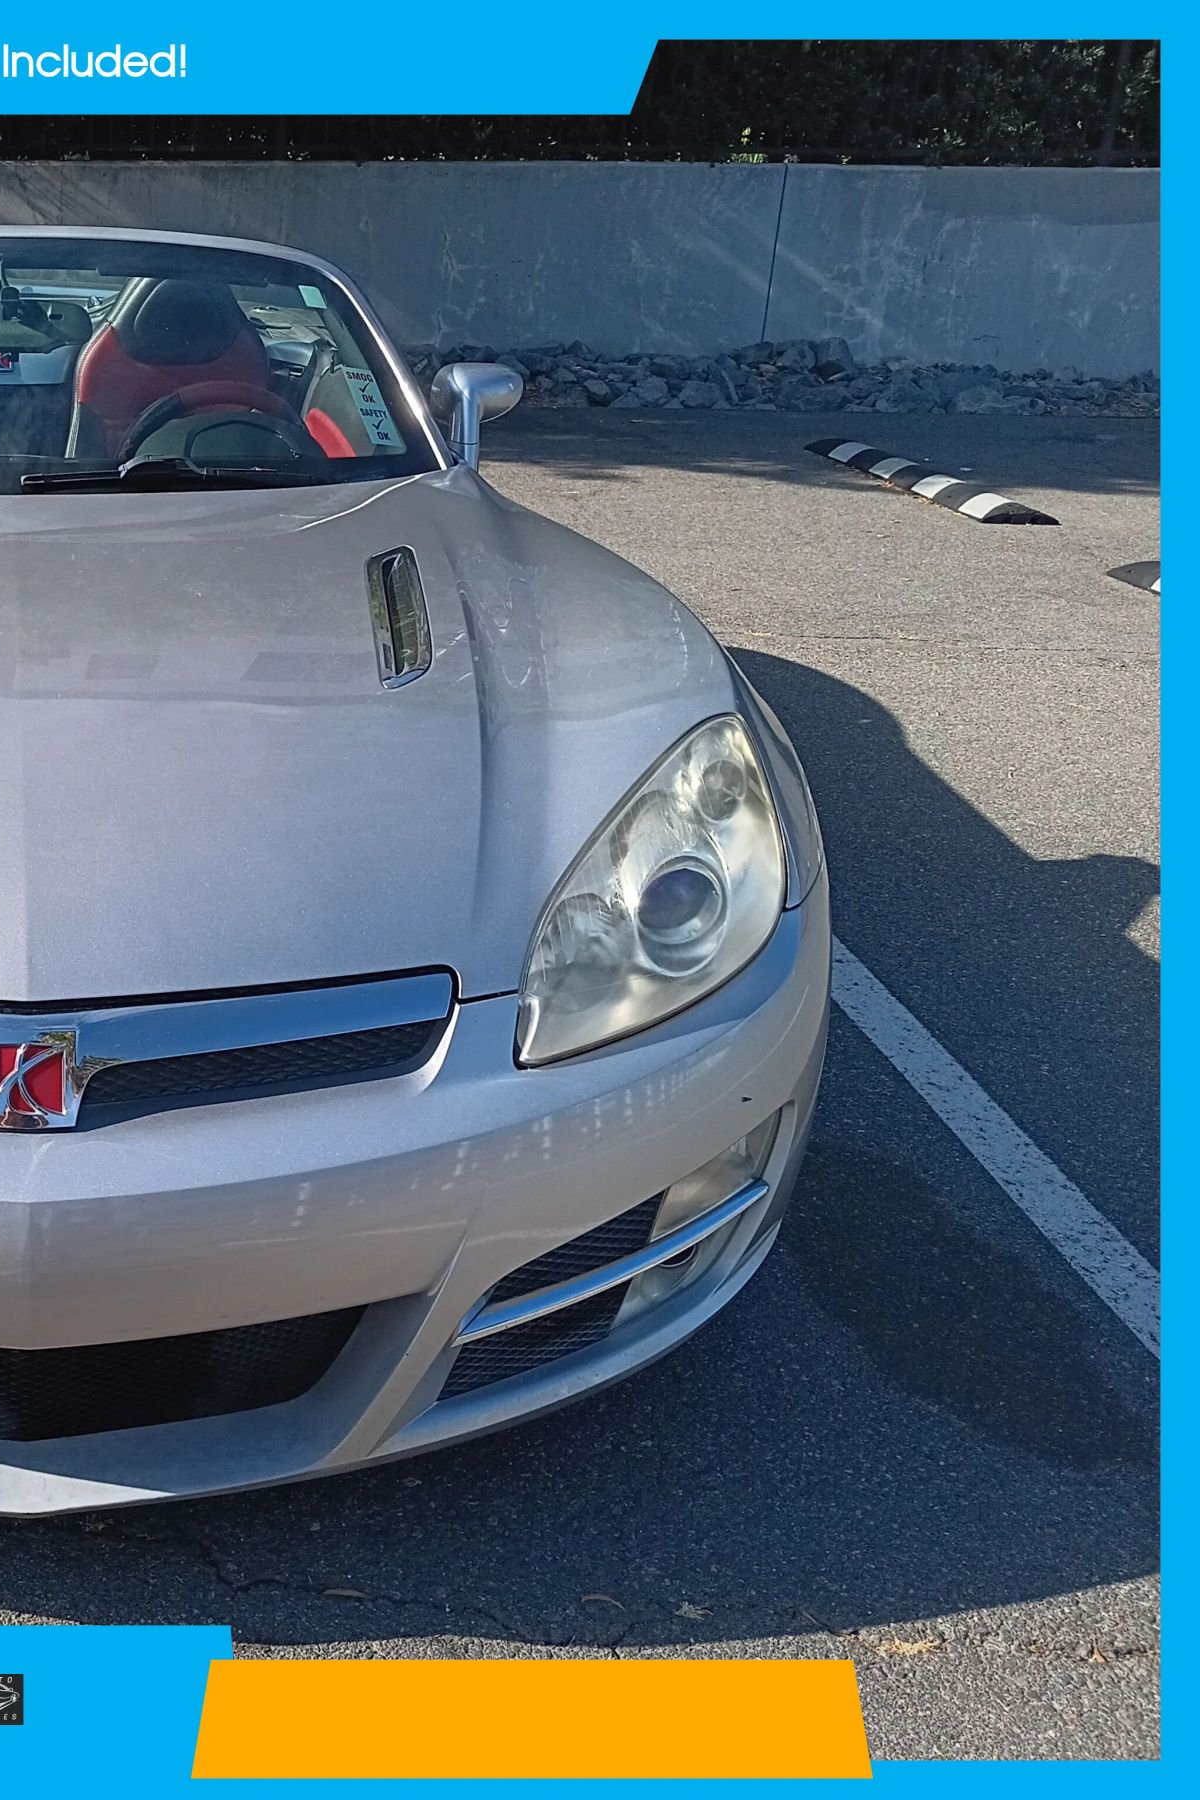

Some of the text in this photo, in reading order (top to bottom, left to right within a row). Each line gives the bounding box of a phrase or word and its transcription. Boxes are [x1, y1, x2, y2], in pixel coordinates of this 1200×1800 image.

[346, 371, 373, 382] SMOG
[362, 394, 376, 403] OK
[360, 408, 387, 419] SAFETY
[377, 432, 391, 441] OK
